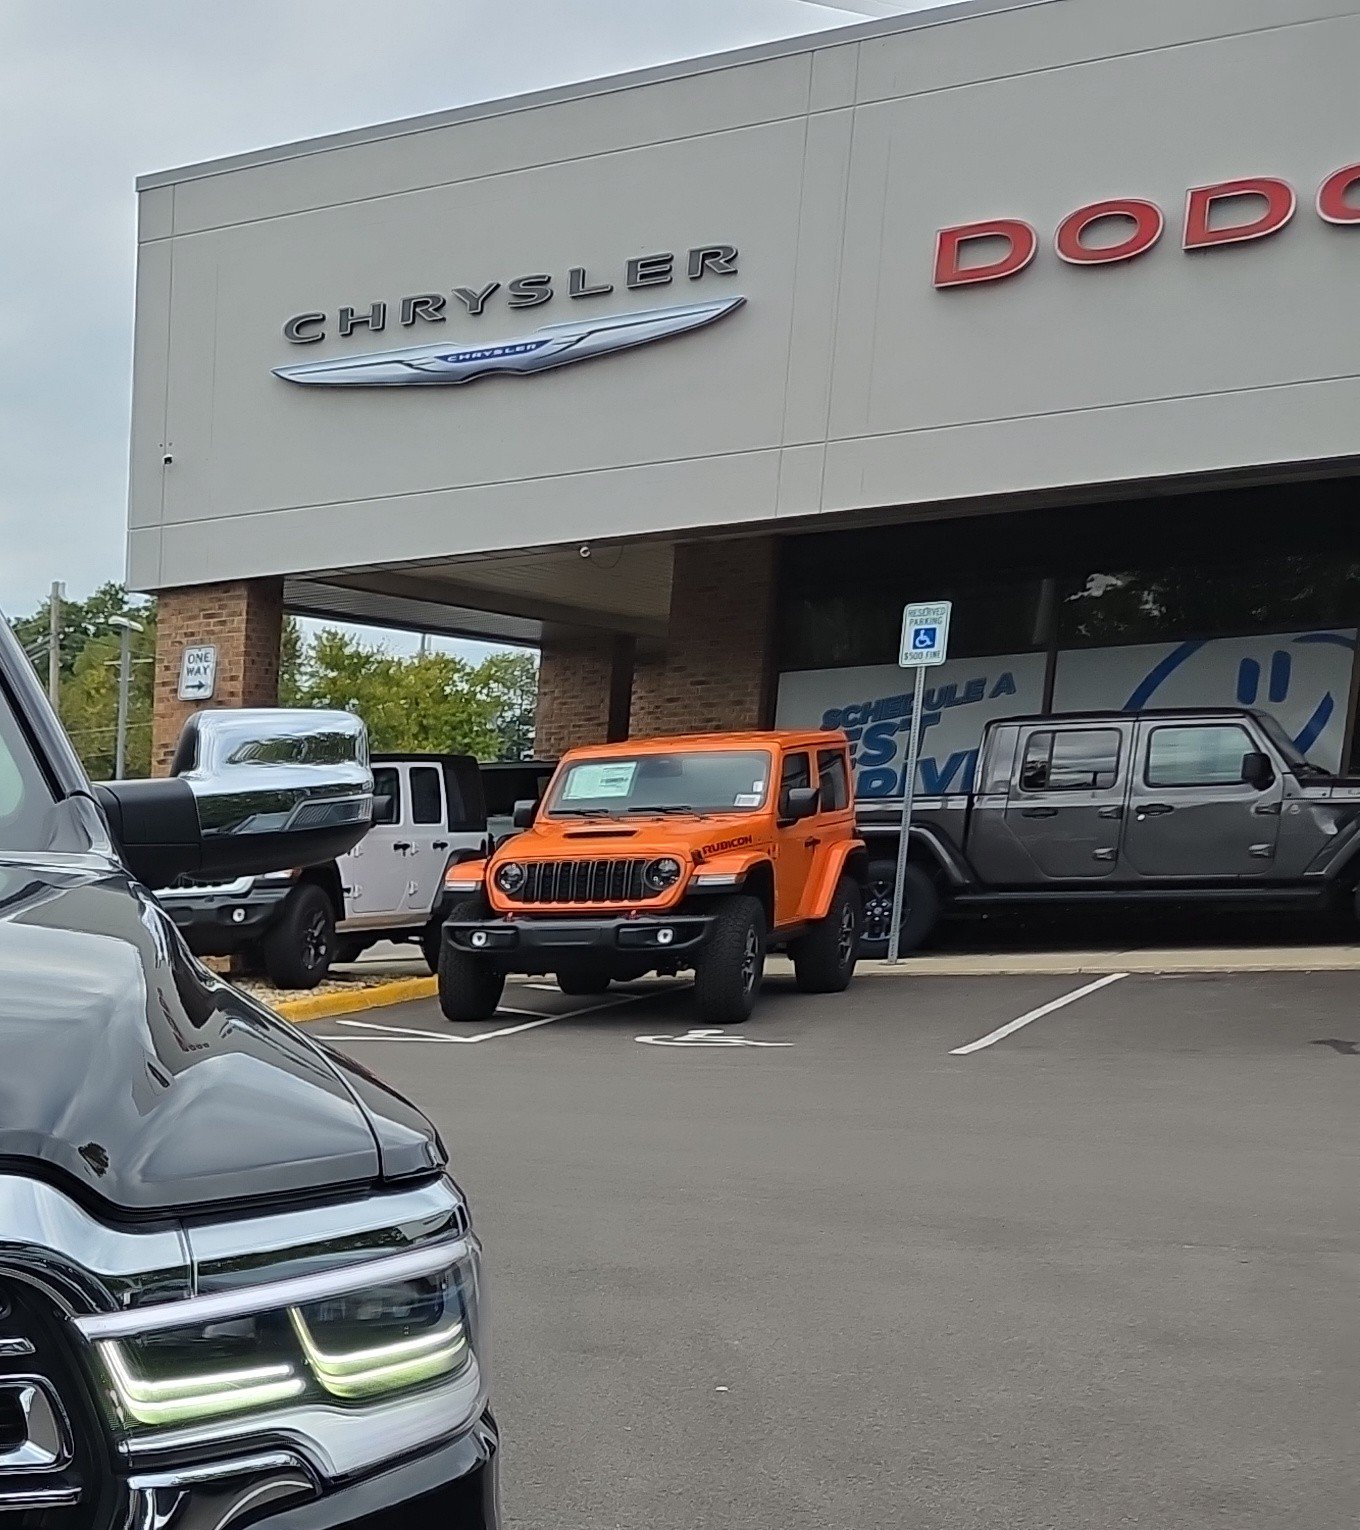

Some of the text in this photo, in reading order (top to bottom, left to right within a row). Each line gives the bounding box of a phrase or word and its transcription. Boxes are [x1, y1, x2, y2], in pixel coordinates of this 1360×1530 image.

[282, 244, 739, 343] CHRYSLER
[446, 343, 537, 362] CHRYSLER
[908, 607, 946, 617] RESERVED
[909, 616, 943, 626] PARKING
[188, 652, 211, 664] ONE
[904, 650, 941, 660] $500 FINE
[187, 665, 210, 676] WAY
[989, 672, 1017, 699] A
[702, 835, 753, 855] RUBICON
